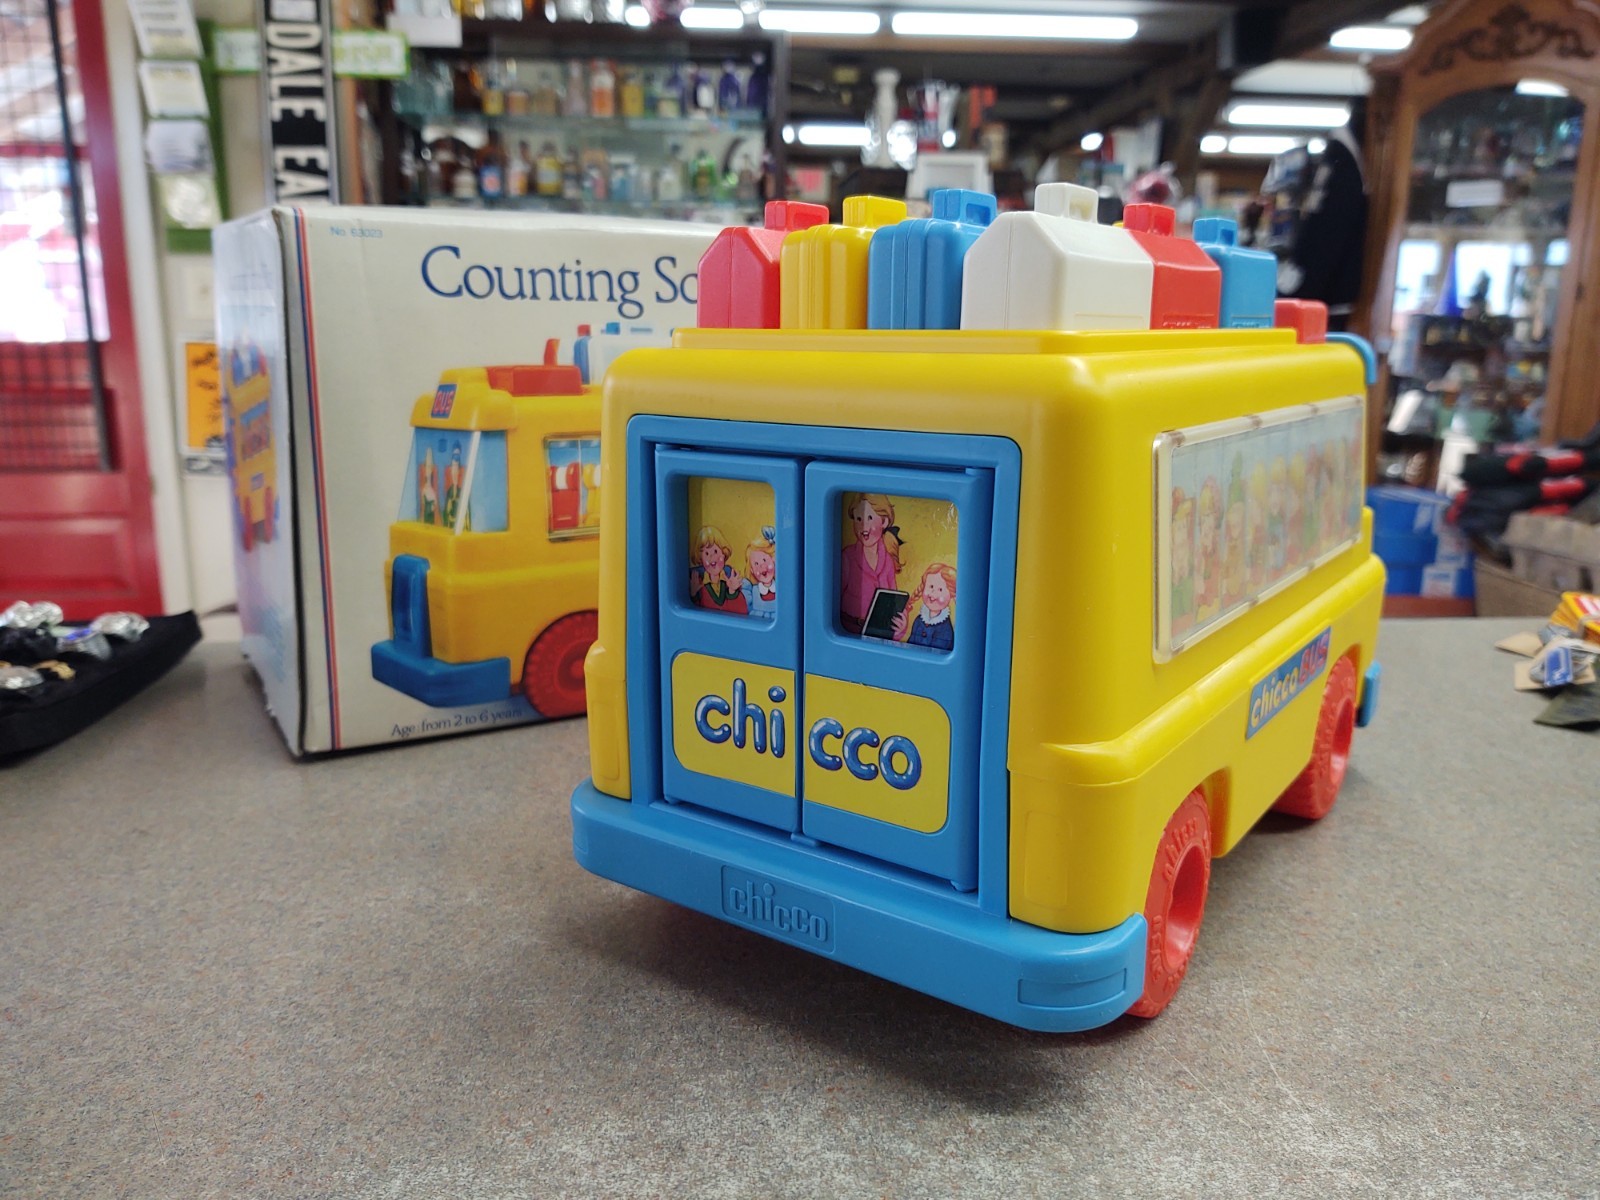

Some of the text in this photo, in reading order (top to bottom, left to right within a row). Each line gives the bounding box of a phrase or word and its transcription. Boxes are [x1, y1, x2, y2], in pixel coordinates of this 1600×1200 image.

[266, 23, 328, 123] DALE
[421, 245, 645, 320] Counting
[1250, 666, 1300, 729] chicco
[1299, 633, 1330, 687] BUS
[421, 719, 452, 732] from
[453, 714, 463, 727] 2
[465, 716, 478, 725] to
[479, 710, 490, 723] 6
[729, 880, 829, 943] chicco
